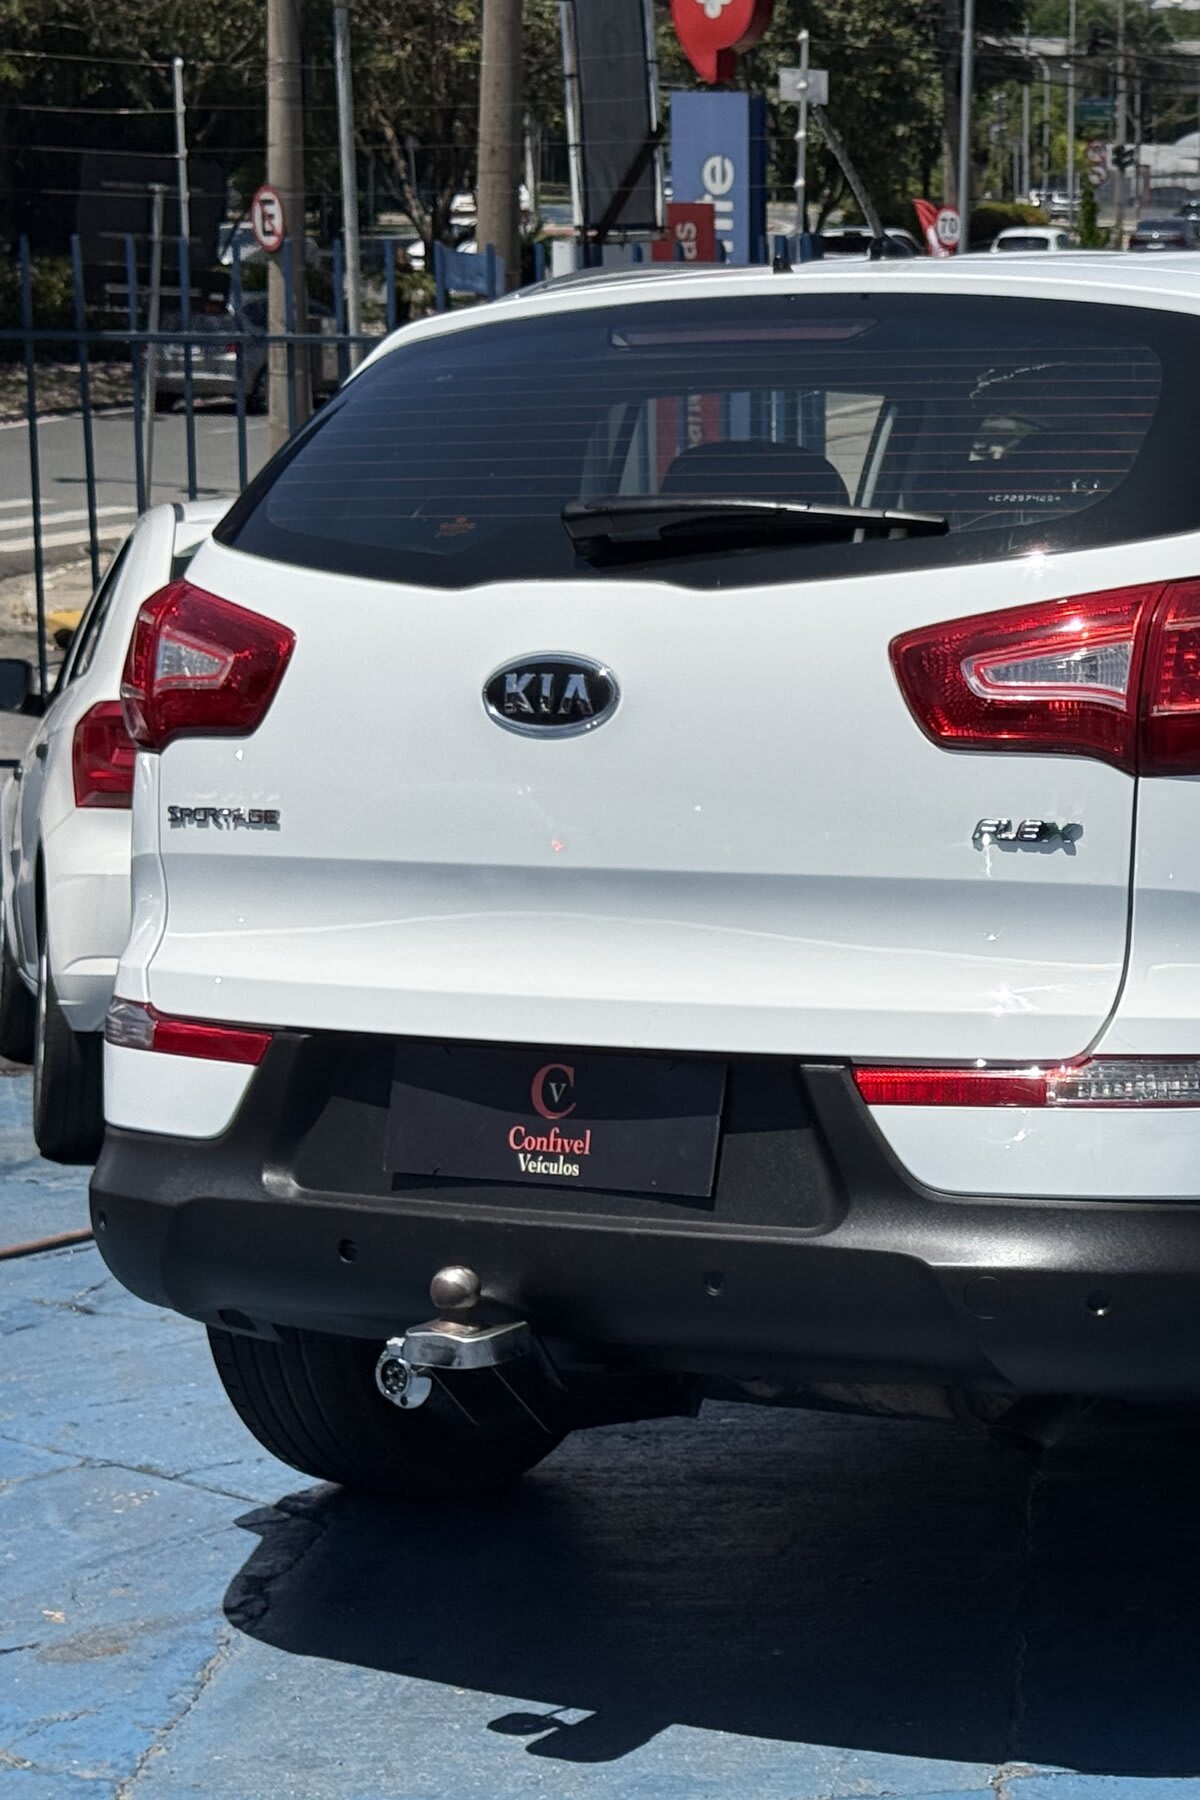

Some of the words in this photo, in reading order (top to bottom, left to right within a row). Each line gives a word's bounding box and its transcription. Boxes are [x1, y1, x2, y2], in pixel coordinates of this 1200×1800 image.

[260, 199, 275, 238] E
[504, 672, 594, 714] KIA
[508, 1125, 591, 1155] Confivel
[518, 1152, 580, 1177] Veículos
